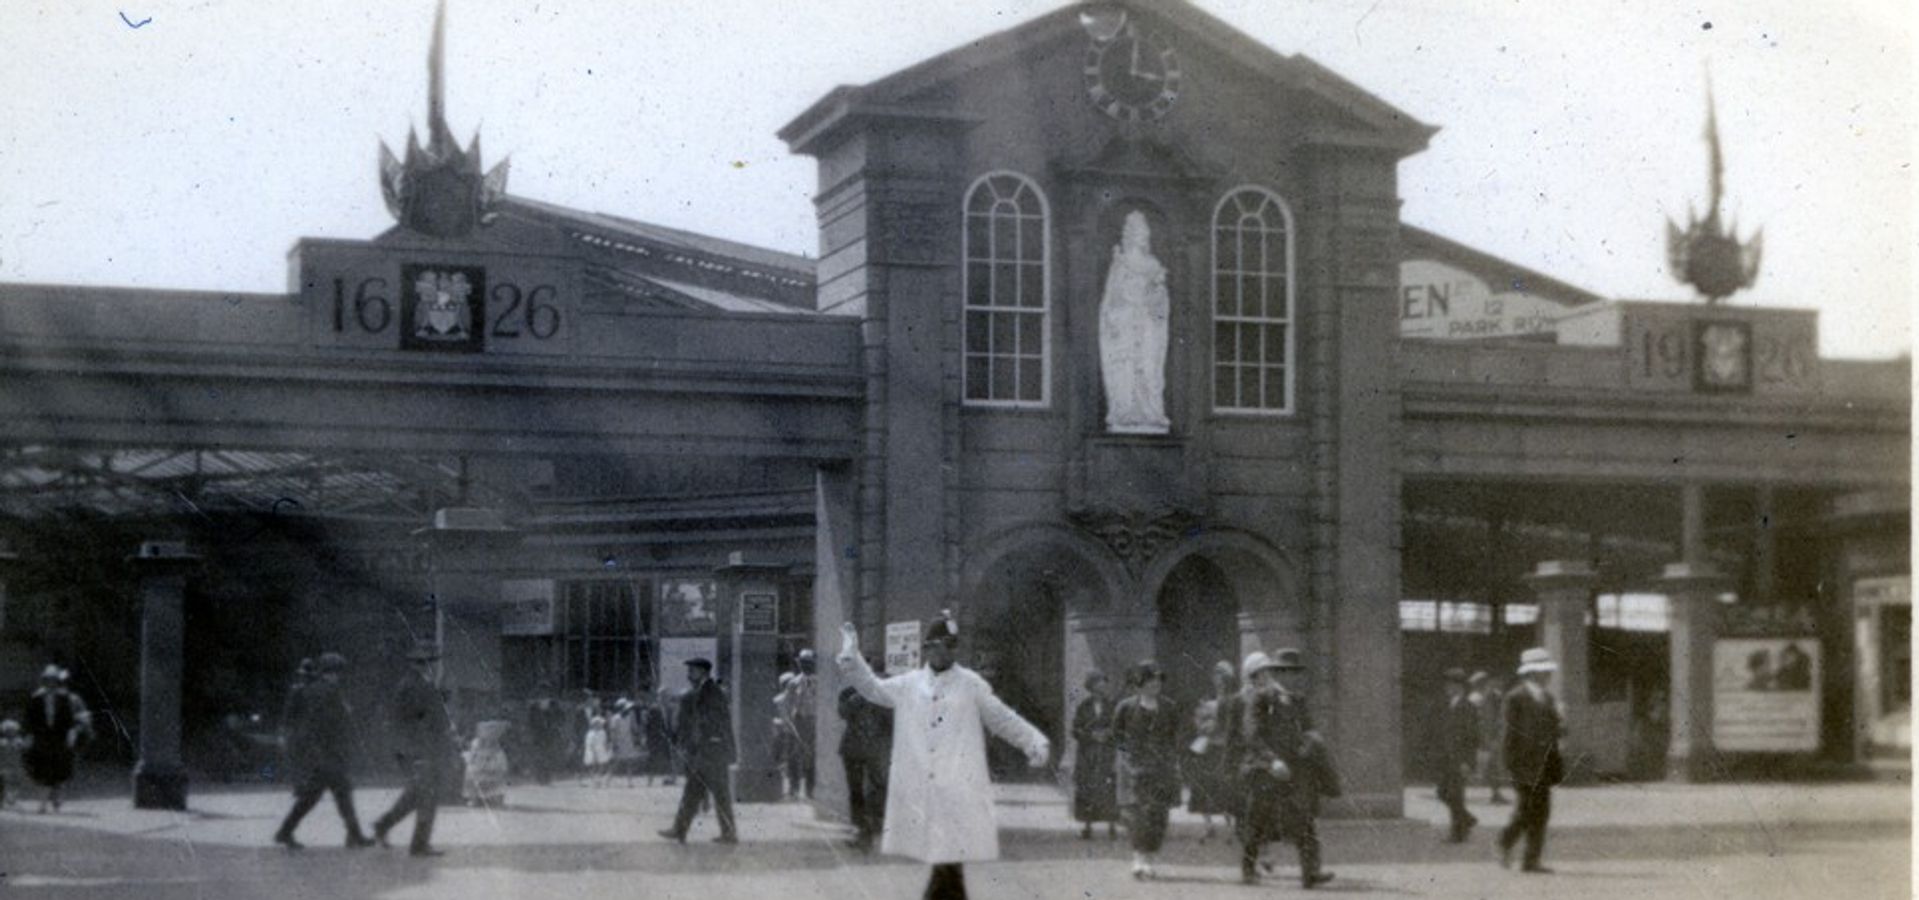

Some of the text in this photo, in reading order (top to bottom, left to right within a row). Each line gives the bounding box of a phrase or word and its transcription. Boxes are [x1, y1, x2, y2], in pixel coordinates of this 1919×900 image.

[334, 277, 560, 340] 16 26
[1449, 320, 1503, 337] PARK
[1641, 329, 1687, 378] 19
